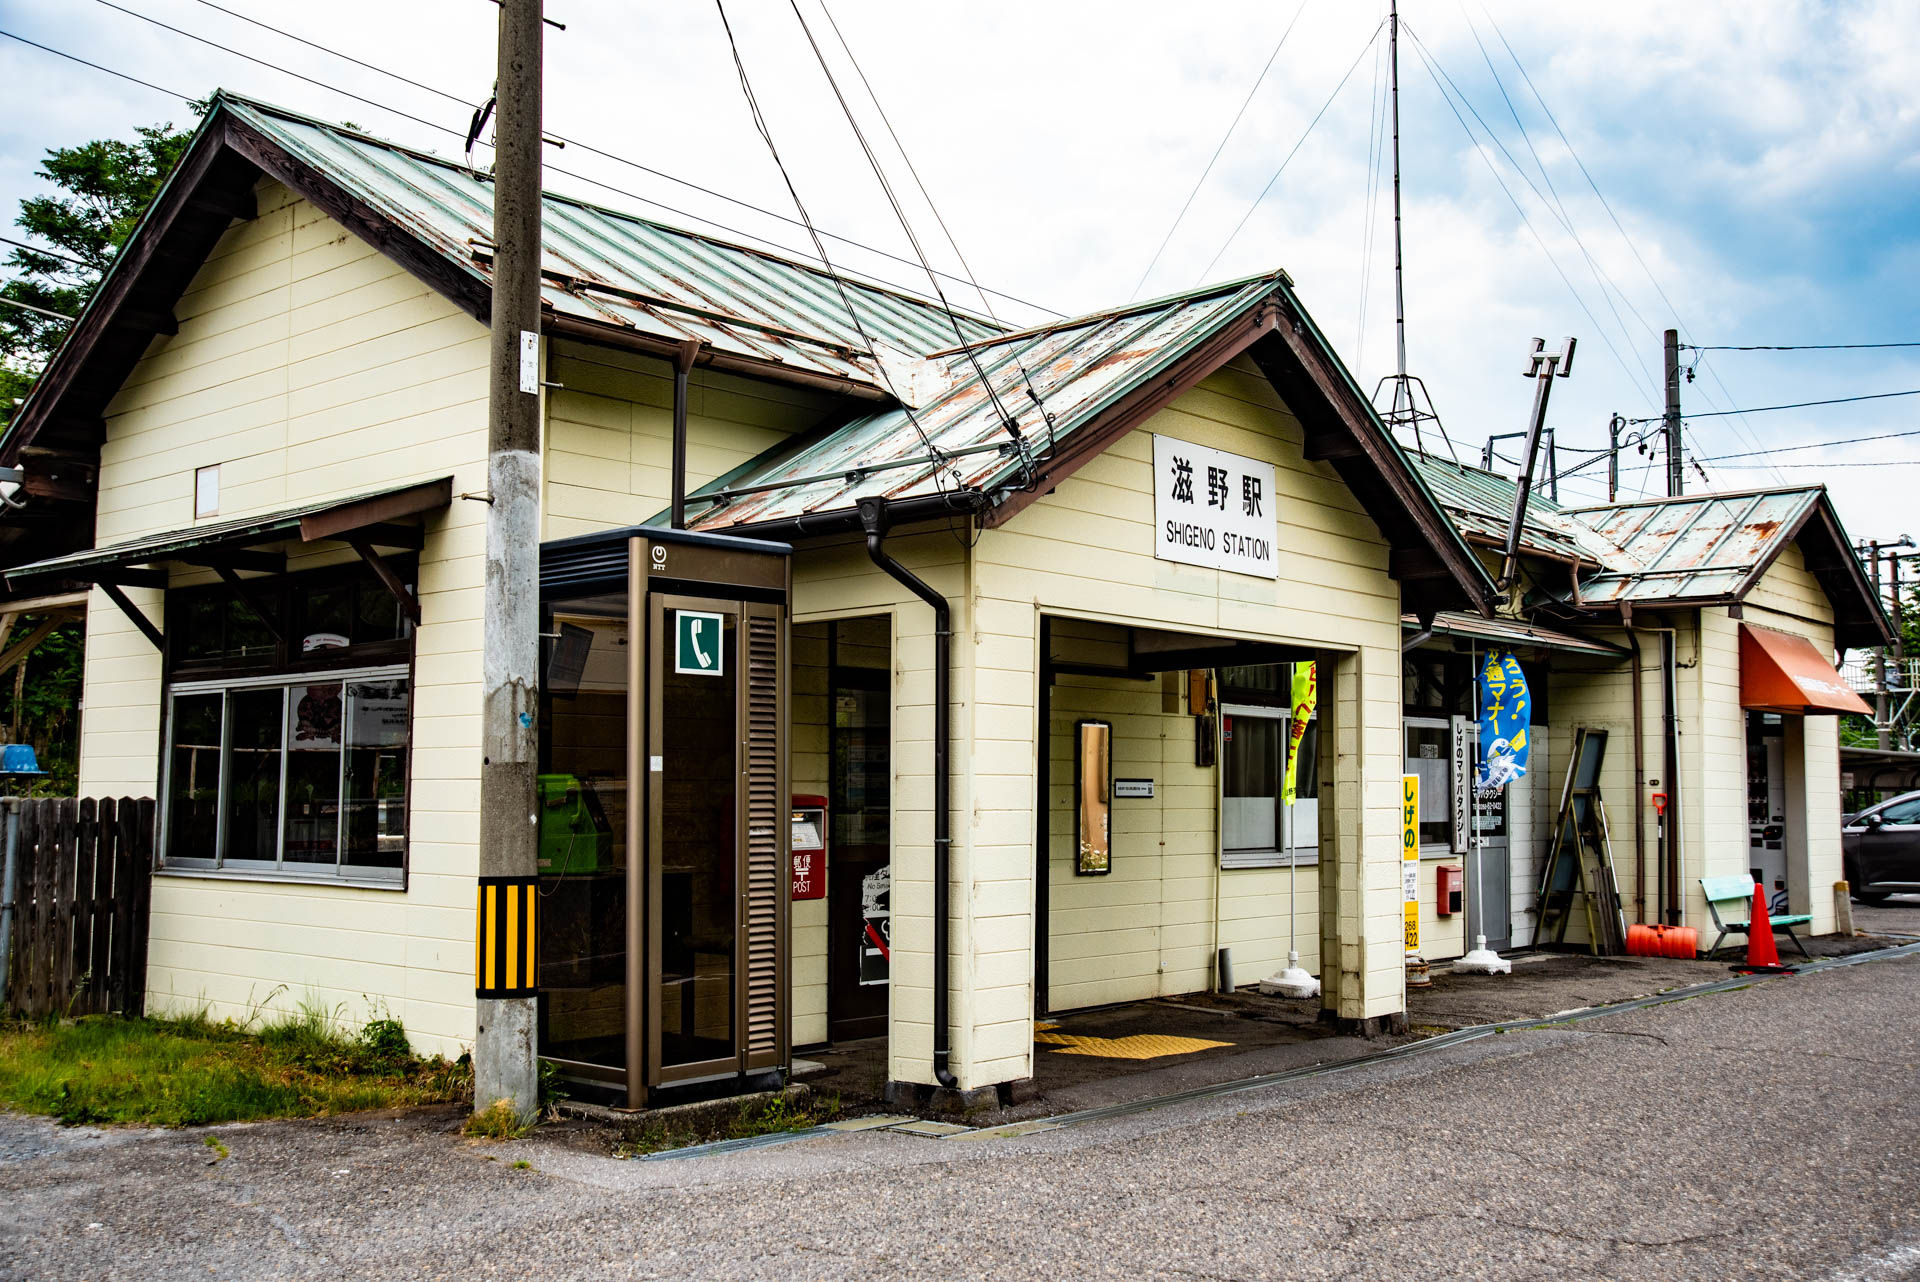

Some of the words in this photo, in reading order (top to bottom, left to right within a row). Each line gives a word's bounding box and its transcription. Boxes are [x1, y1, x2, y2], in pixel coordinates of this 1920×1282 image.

[1171, 455, 1263, 518] 滋野駅
[1166, 520, 1216, 551] SHIGENO
[1223, 531, 1270, 561] STATION
[653, 563, 666, 571] NTT
[1404, 781, 1415, 849] しげの
[793, 854, 812, 869] 郵便
[793, 881, 811, 893] POST
[867, 882, 876, 890] No
